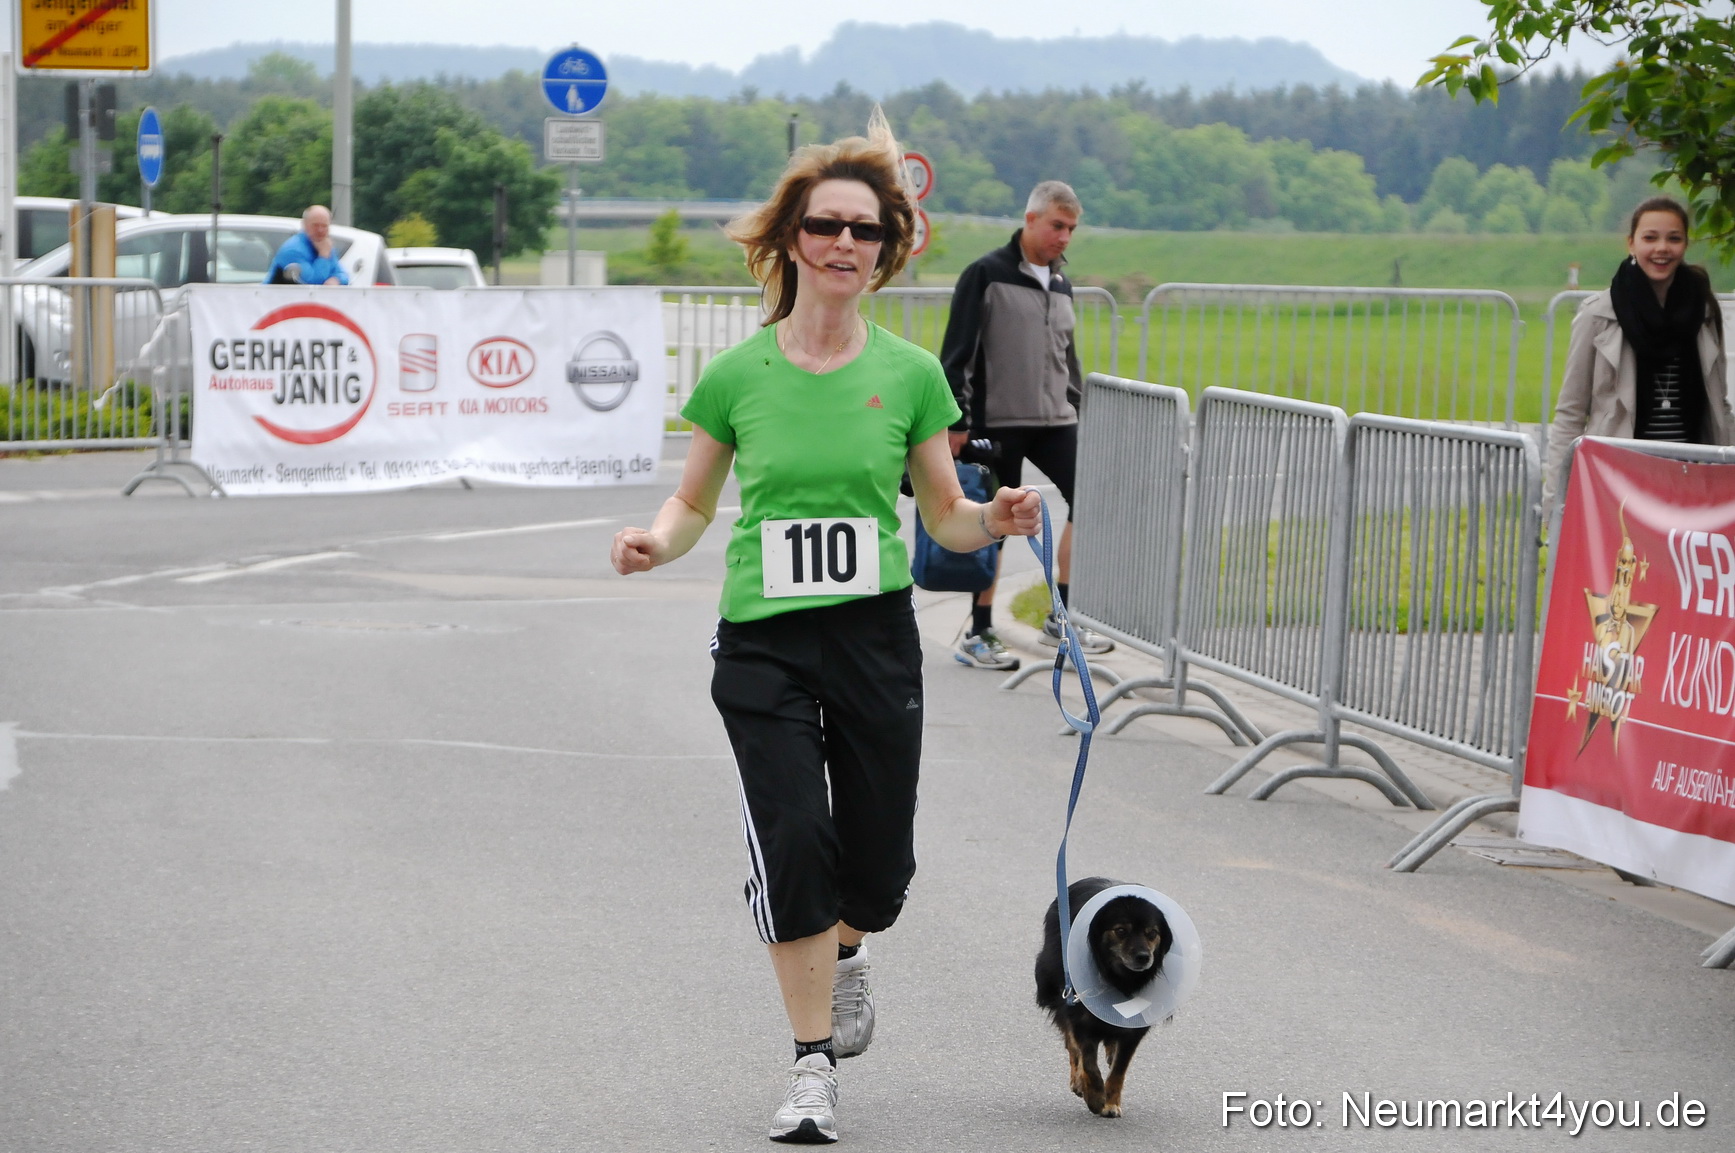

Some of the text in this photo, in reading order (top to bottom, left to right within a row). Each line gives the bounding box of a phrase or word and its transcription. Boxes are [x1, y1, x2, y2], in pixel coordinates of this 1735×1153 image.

[209, 338, 358, 371] GERHART &
[478, 348, 523, 376] KIA
[208, 374, 274, 391] Autohaus
[572, 363, 633, 380] NISSAN
[272, 371, 362, 405] JÄNIG
[387, 401, 449, 417] SEAT
[458, 396, 549, 415] KIA MOTORS
[206, 463, 264, 486] Neumarkt
[275, 461, 347, 487] Sengenthal
[785, 521, 857, 583] 110
[1668, 527, 1735, 619] VER
[1661, 631, 1735, 718] KUND
[1651, 760, 1677, 793] AUF
